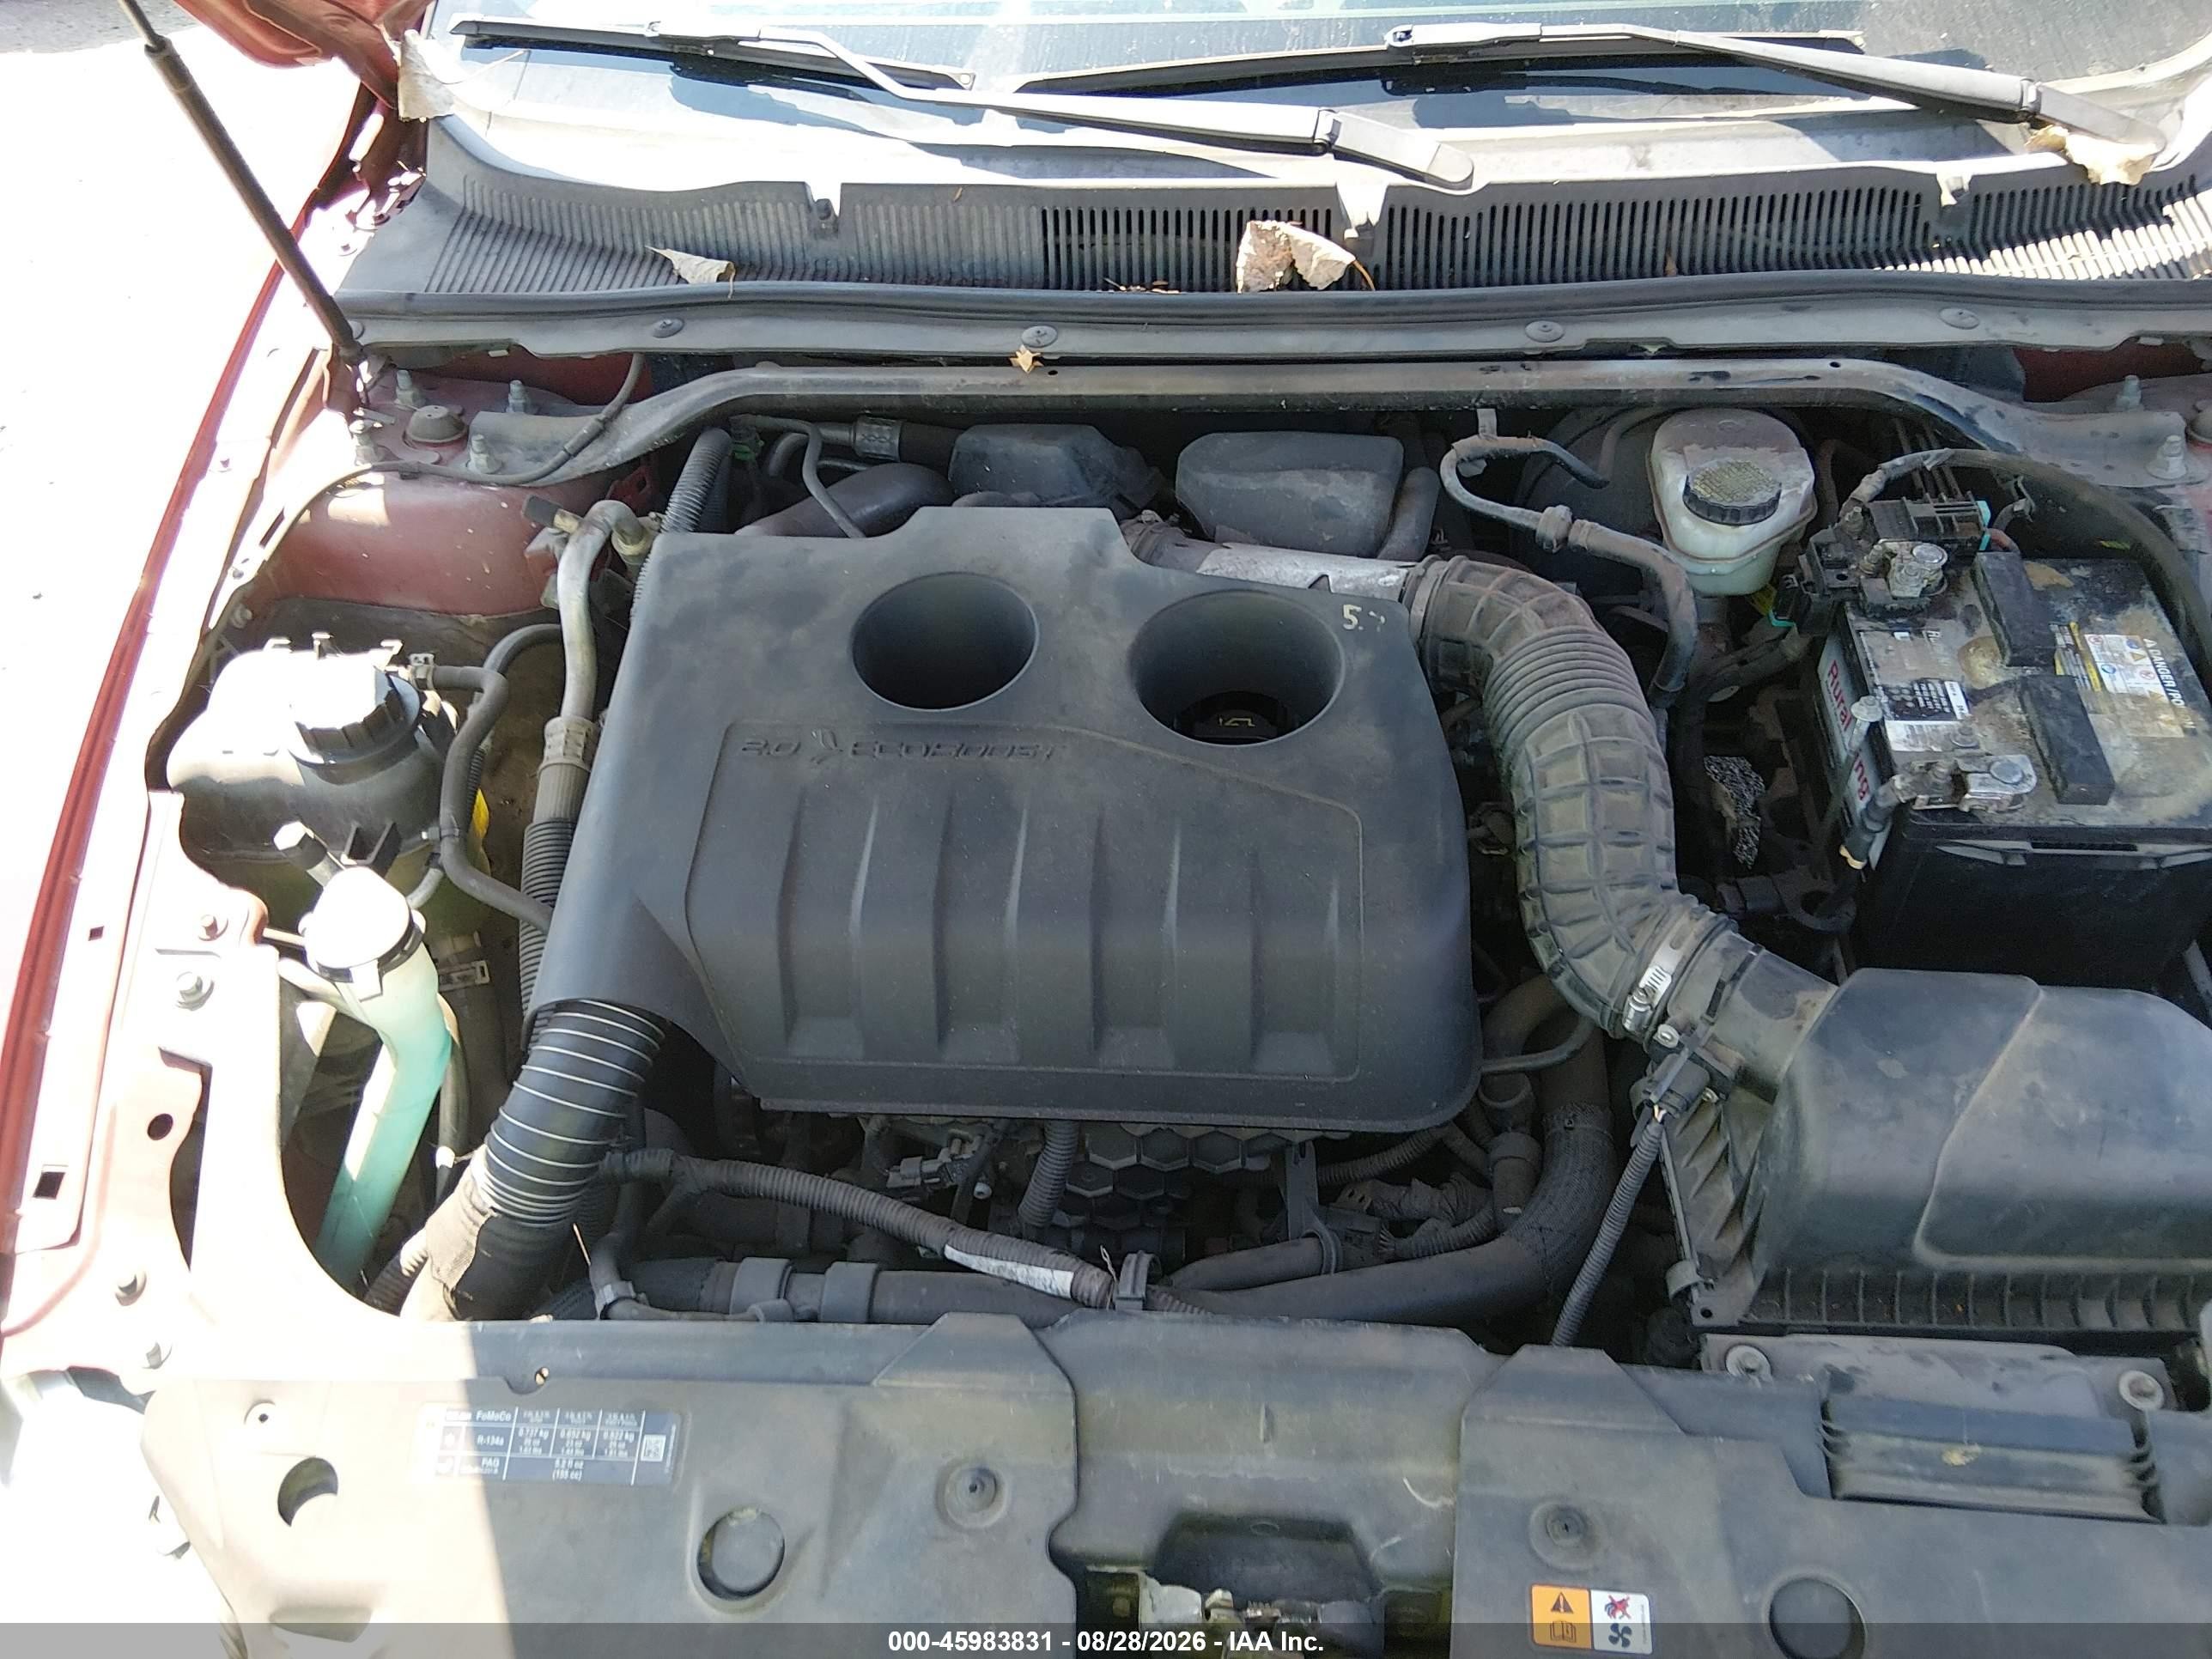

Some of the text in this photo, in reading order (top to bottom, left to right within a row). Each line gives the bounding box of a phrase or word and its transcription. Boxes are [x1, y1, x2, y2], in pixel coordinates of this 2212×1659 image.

[1829, 659, 1852, 731] Rural
[476, 1410, 512, 1422] FoMoCo
[477, 1434, 504, 1446] R-134a
